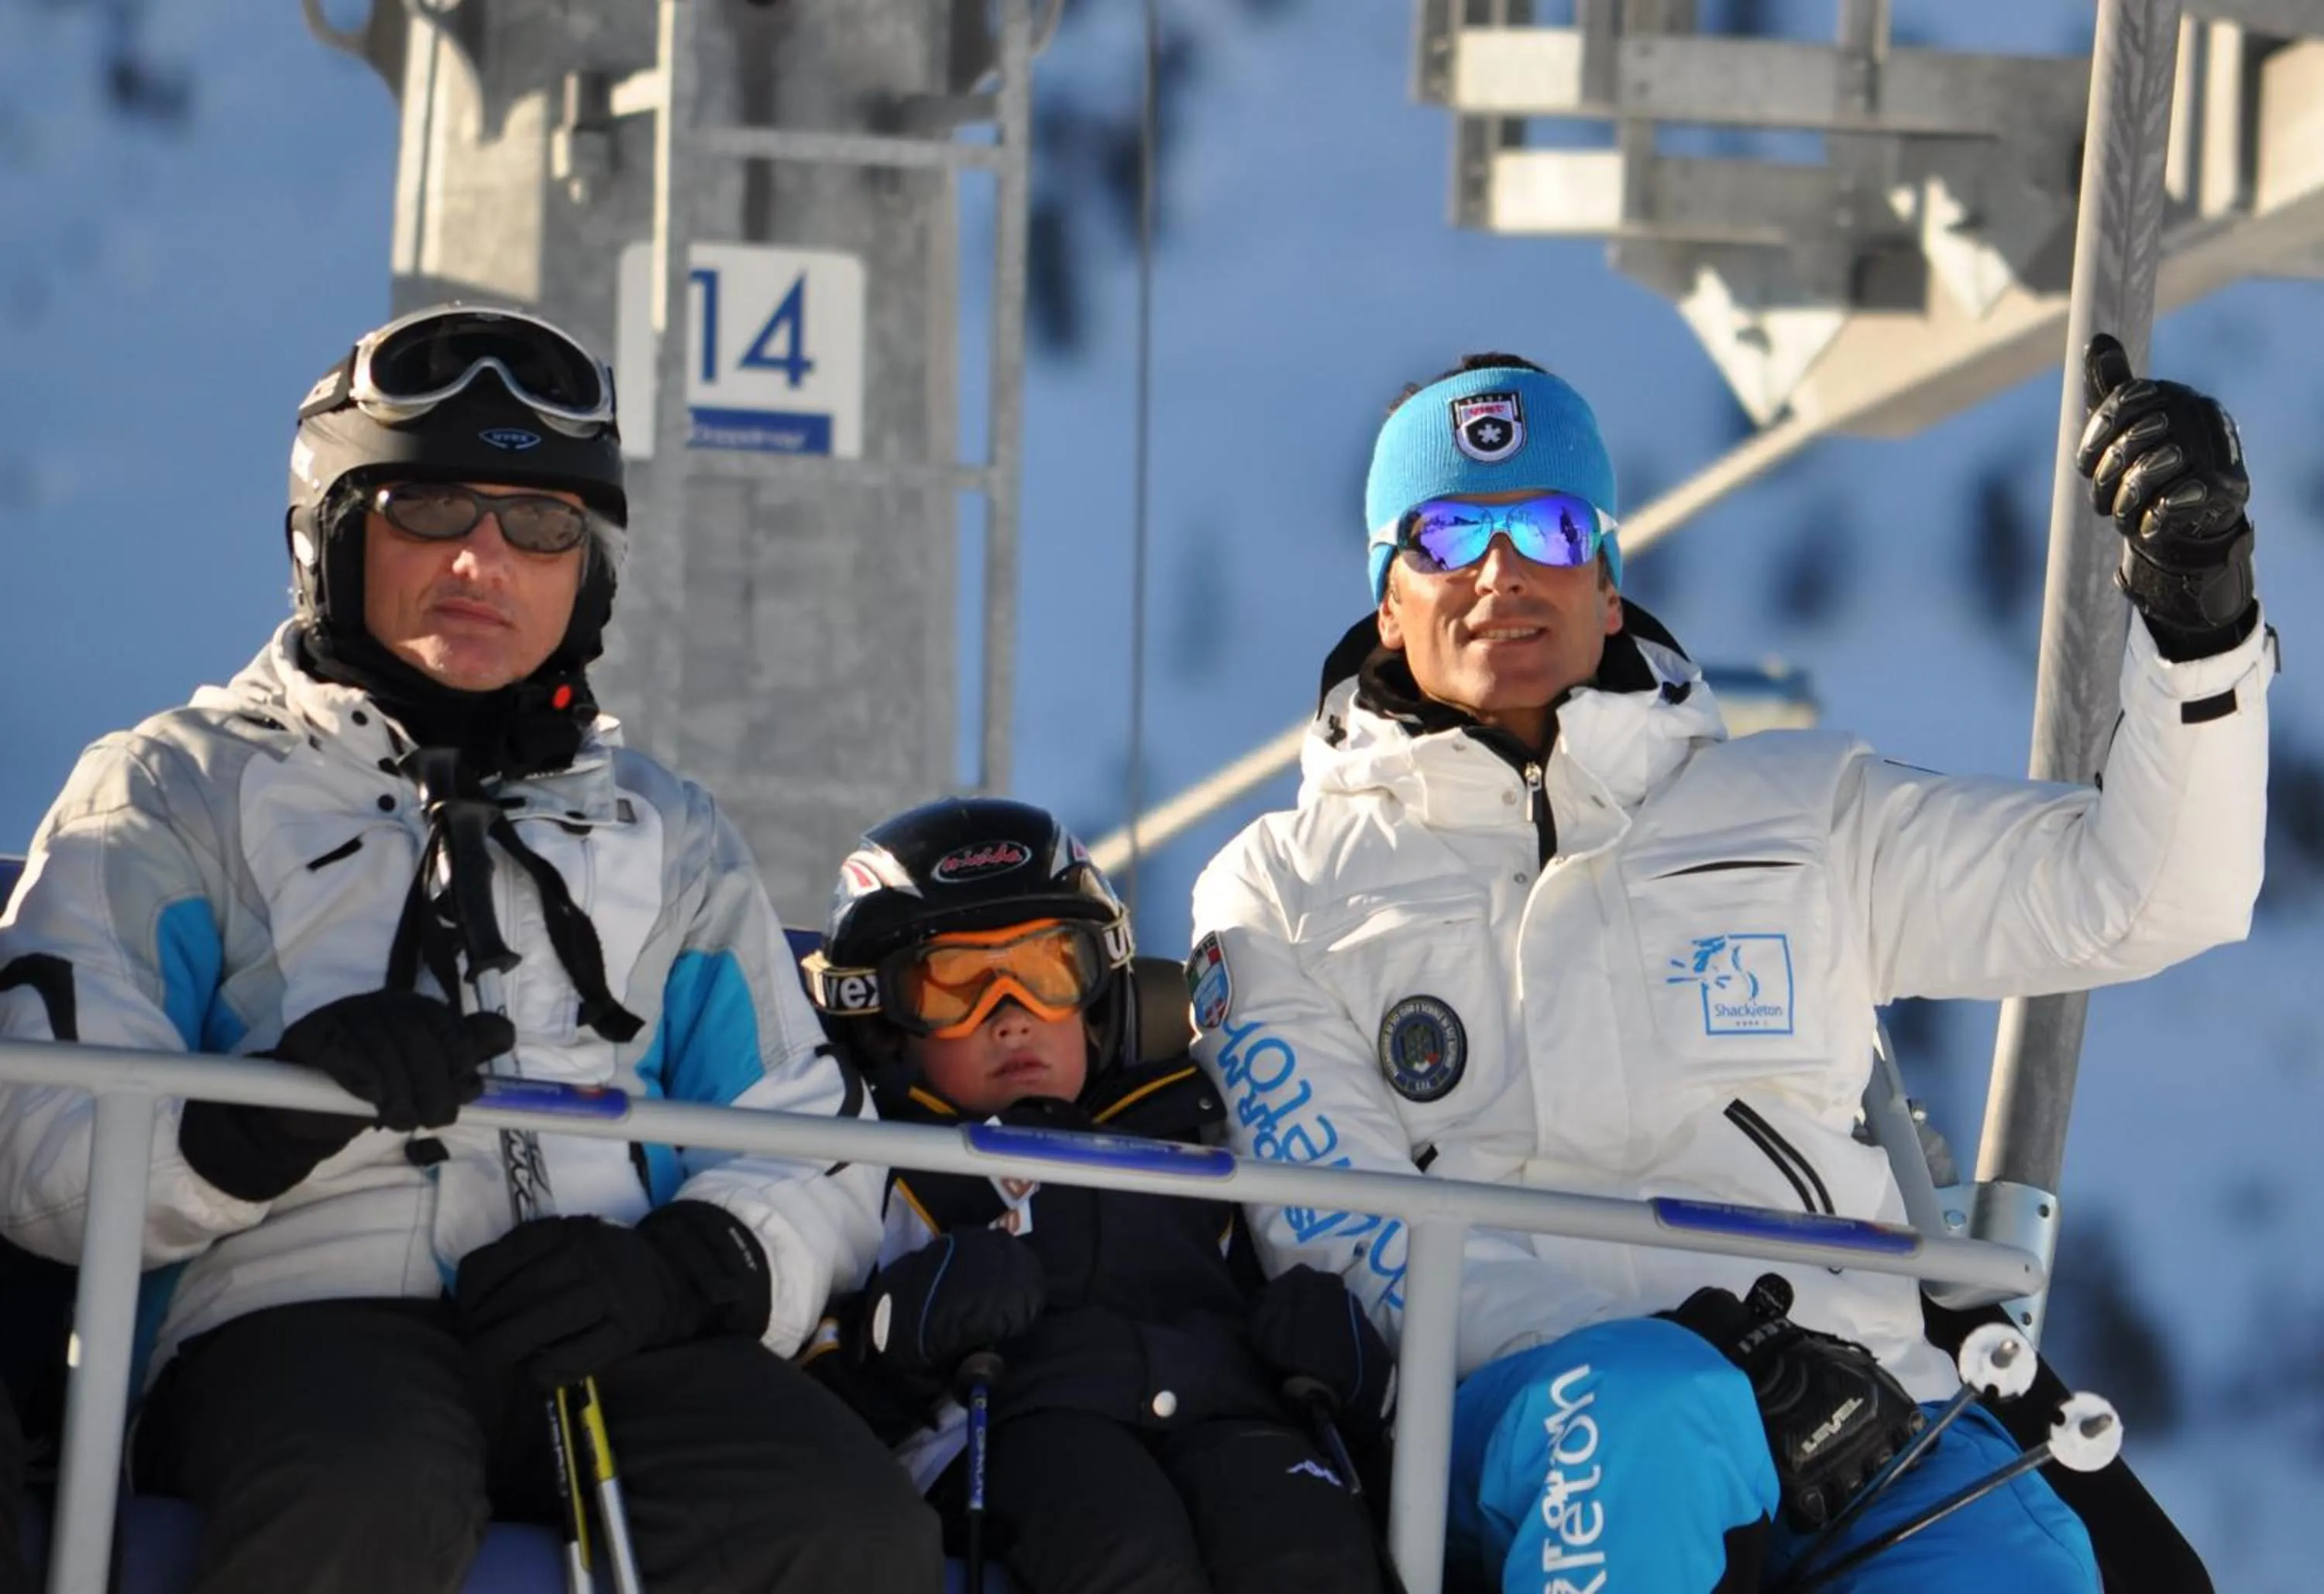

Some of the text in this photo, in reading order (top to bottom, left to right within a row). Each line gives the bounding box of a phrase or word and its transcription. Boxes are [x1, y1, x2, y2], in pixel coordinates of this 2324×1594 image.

[689, 268, 814, 389] 14
[826, 974, 881, 1010] vex
[1714, 1003, 1783, 1018] Shackleton
[1800, 1396, 1864, 1454] LEVEL
